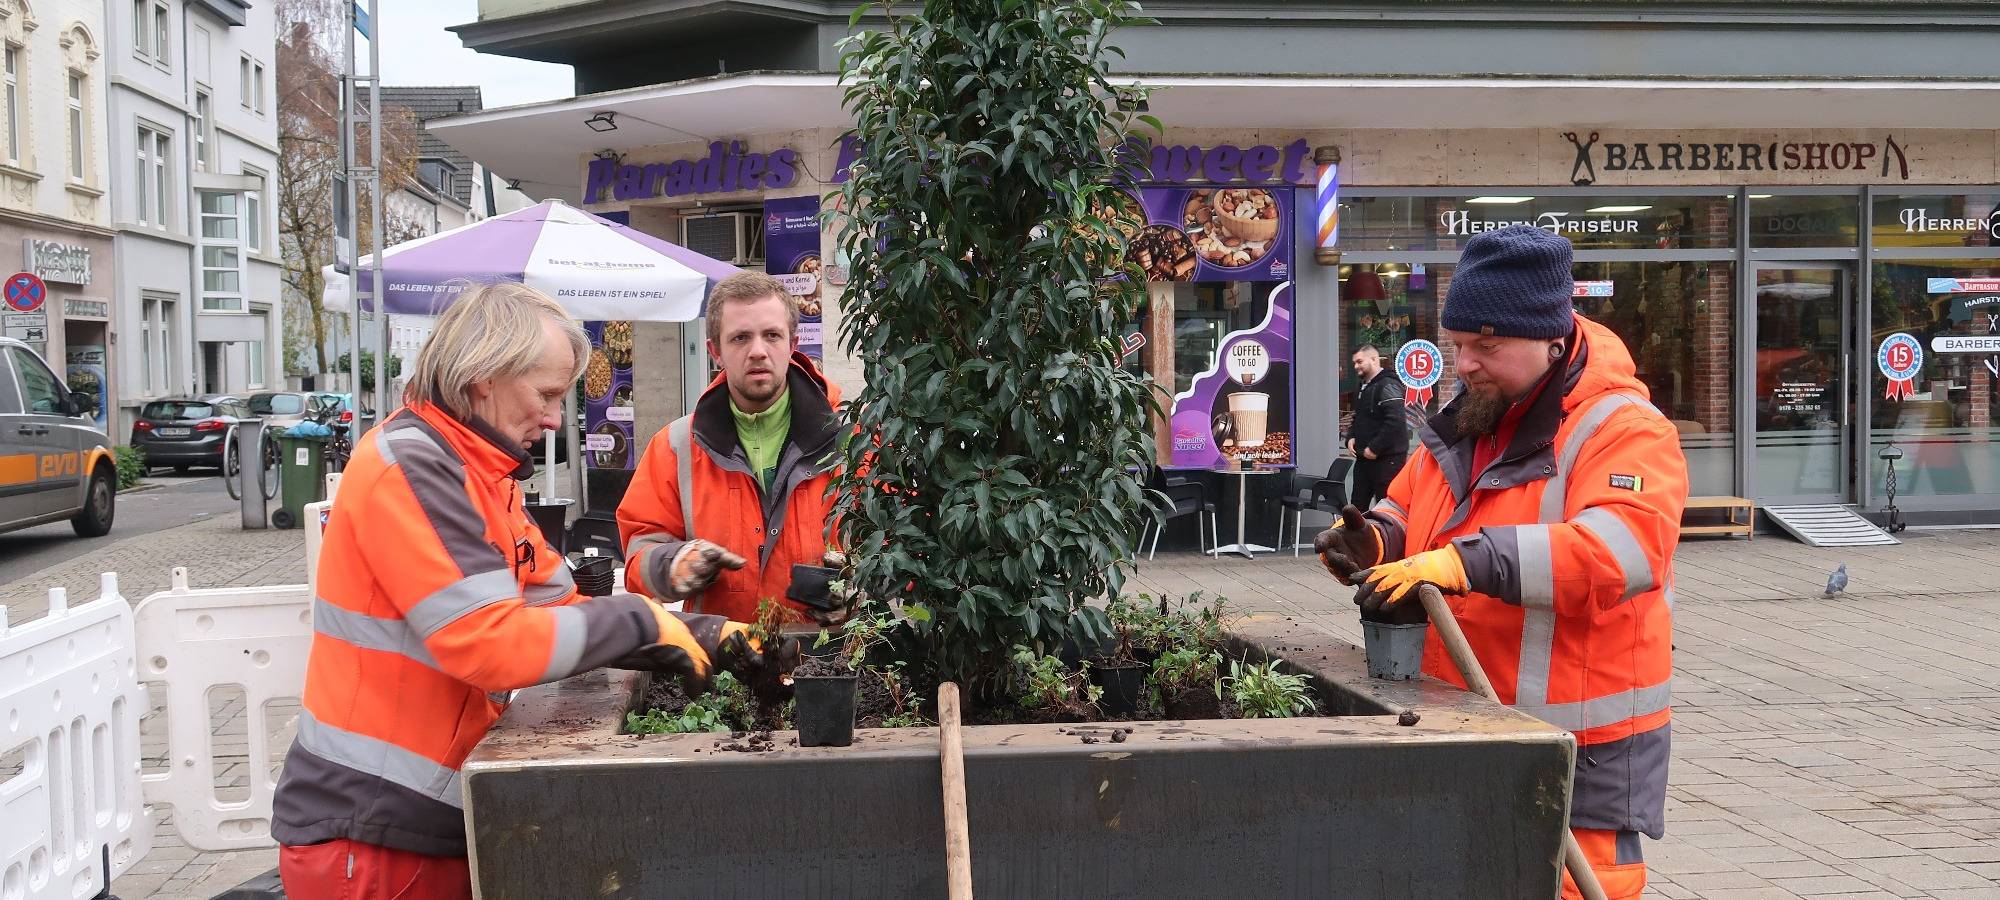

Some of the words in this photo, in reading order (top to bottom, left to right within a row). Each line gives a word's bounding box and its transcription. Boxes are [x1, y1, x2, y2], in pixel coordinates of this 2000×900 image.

[1603, 143, 1765, 171] BARBER
[1783, 142, 1876, 170] SHOP
[583, 139, 797, 205] Paradies
[389, 283, 406, 291] DAS
[406, 284, 433, 292] LEBEN
[433, 285, 447, 293] IST
[558, 289, 576, 297] DAS
[578, 289, 606, 298] LEBEN
[608, 290, 621, 298] IST
[623, 290, 638, 298] EIN
[639, 291, 666, 299] SPIEL!
[1232, 345, 1262, 356] COFFEE
[1891, 346, 1909, 362] 15
[1237, 358, 1246, 367] TO
[1247, 358, 1256, 367] GO
[1409, 353, 1428, 370] 15
[1261, 450, 1284, 459] lecker
